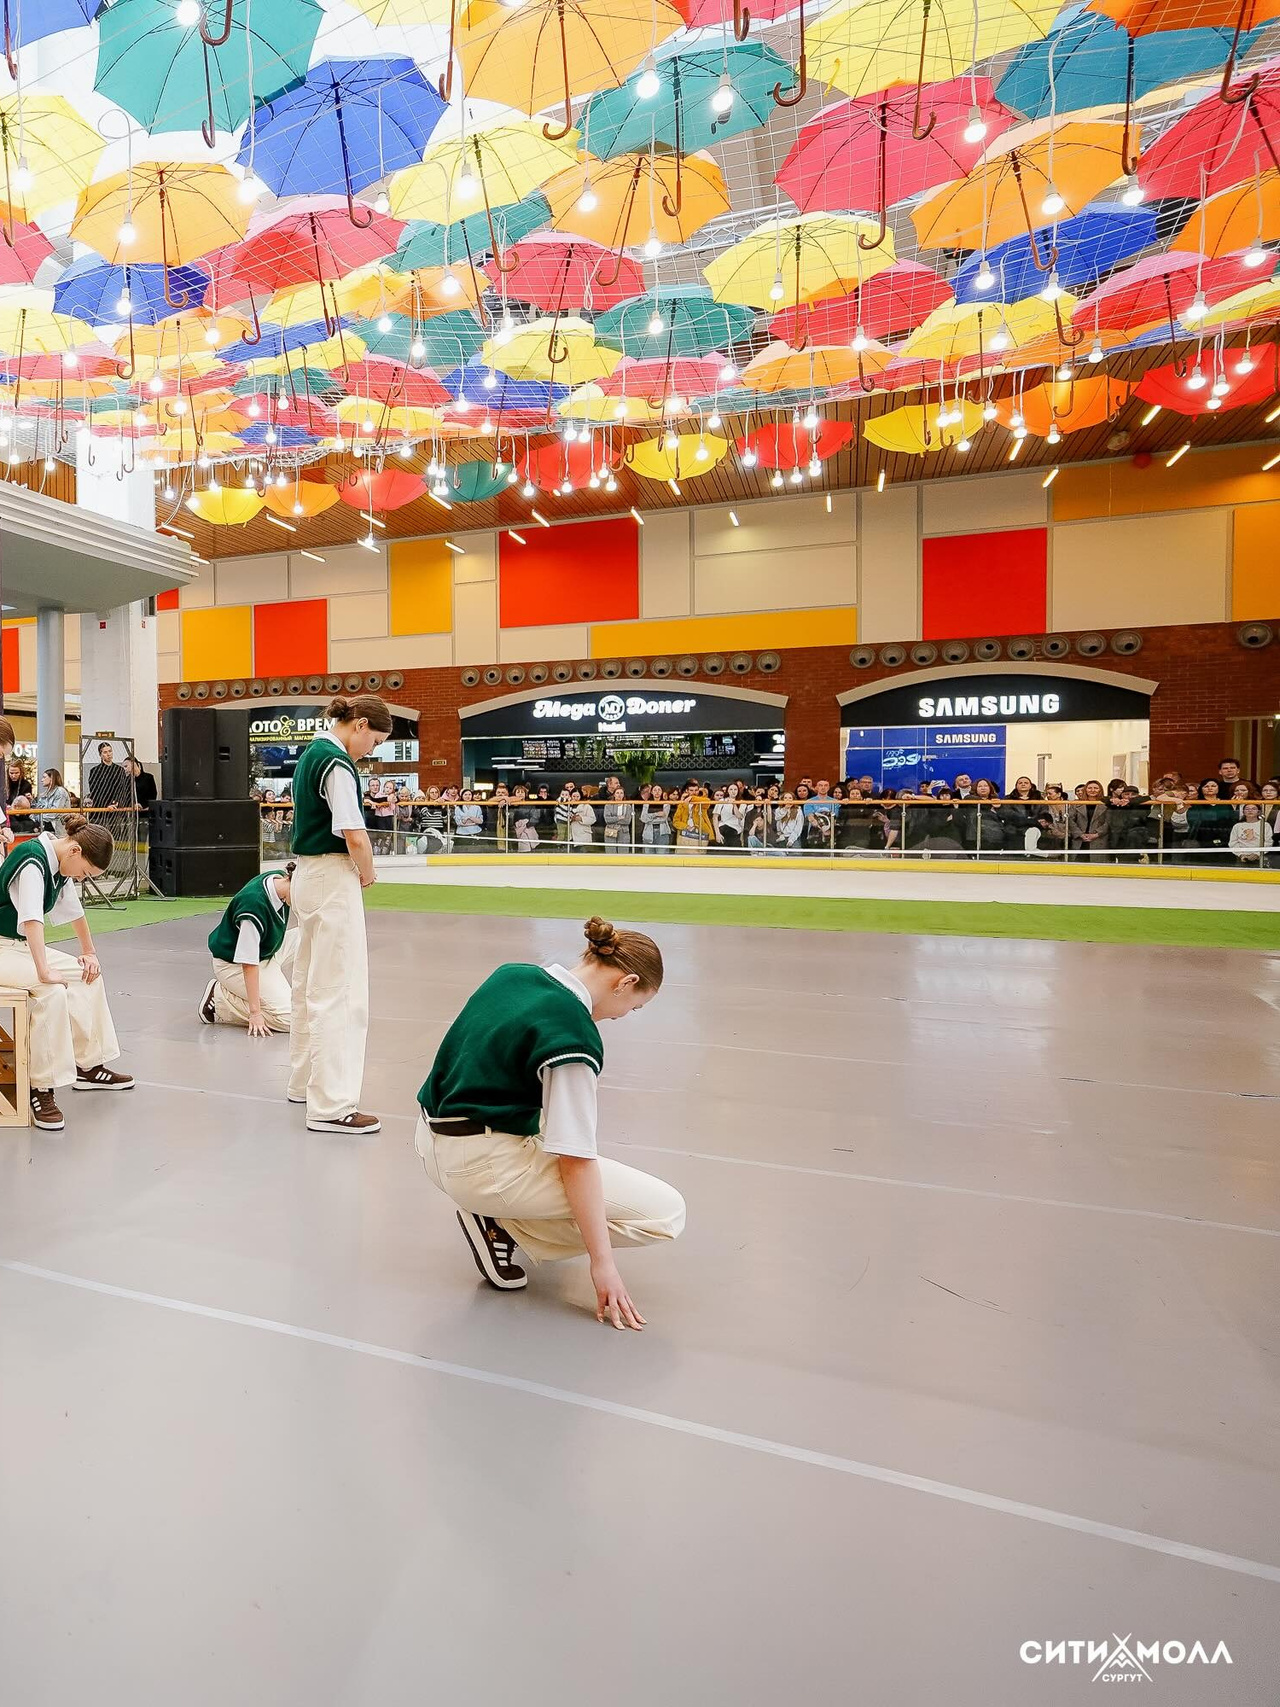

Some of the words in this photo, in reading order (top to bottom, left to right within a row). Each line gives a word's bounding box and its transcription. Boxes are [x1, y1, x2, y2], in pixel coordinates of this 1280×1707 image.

[532, 699, 596, 721] Mega
[626, 697, 697, 715] Doner
[918, 693, 1061, 718] SAMSUNG
[297, 717, 336, 732] ВРЕМ
[935, 733, 997, 744] SAMSUNG
